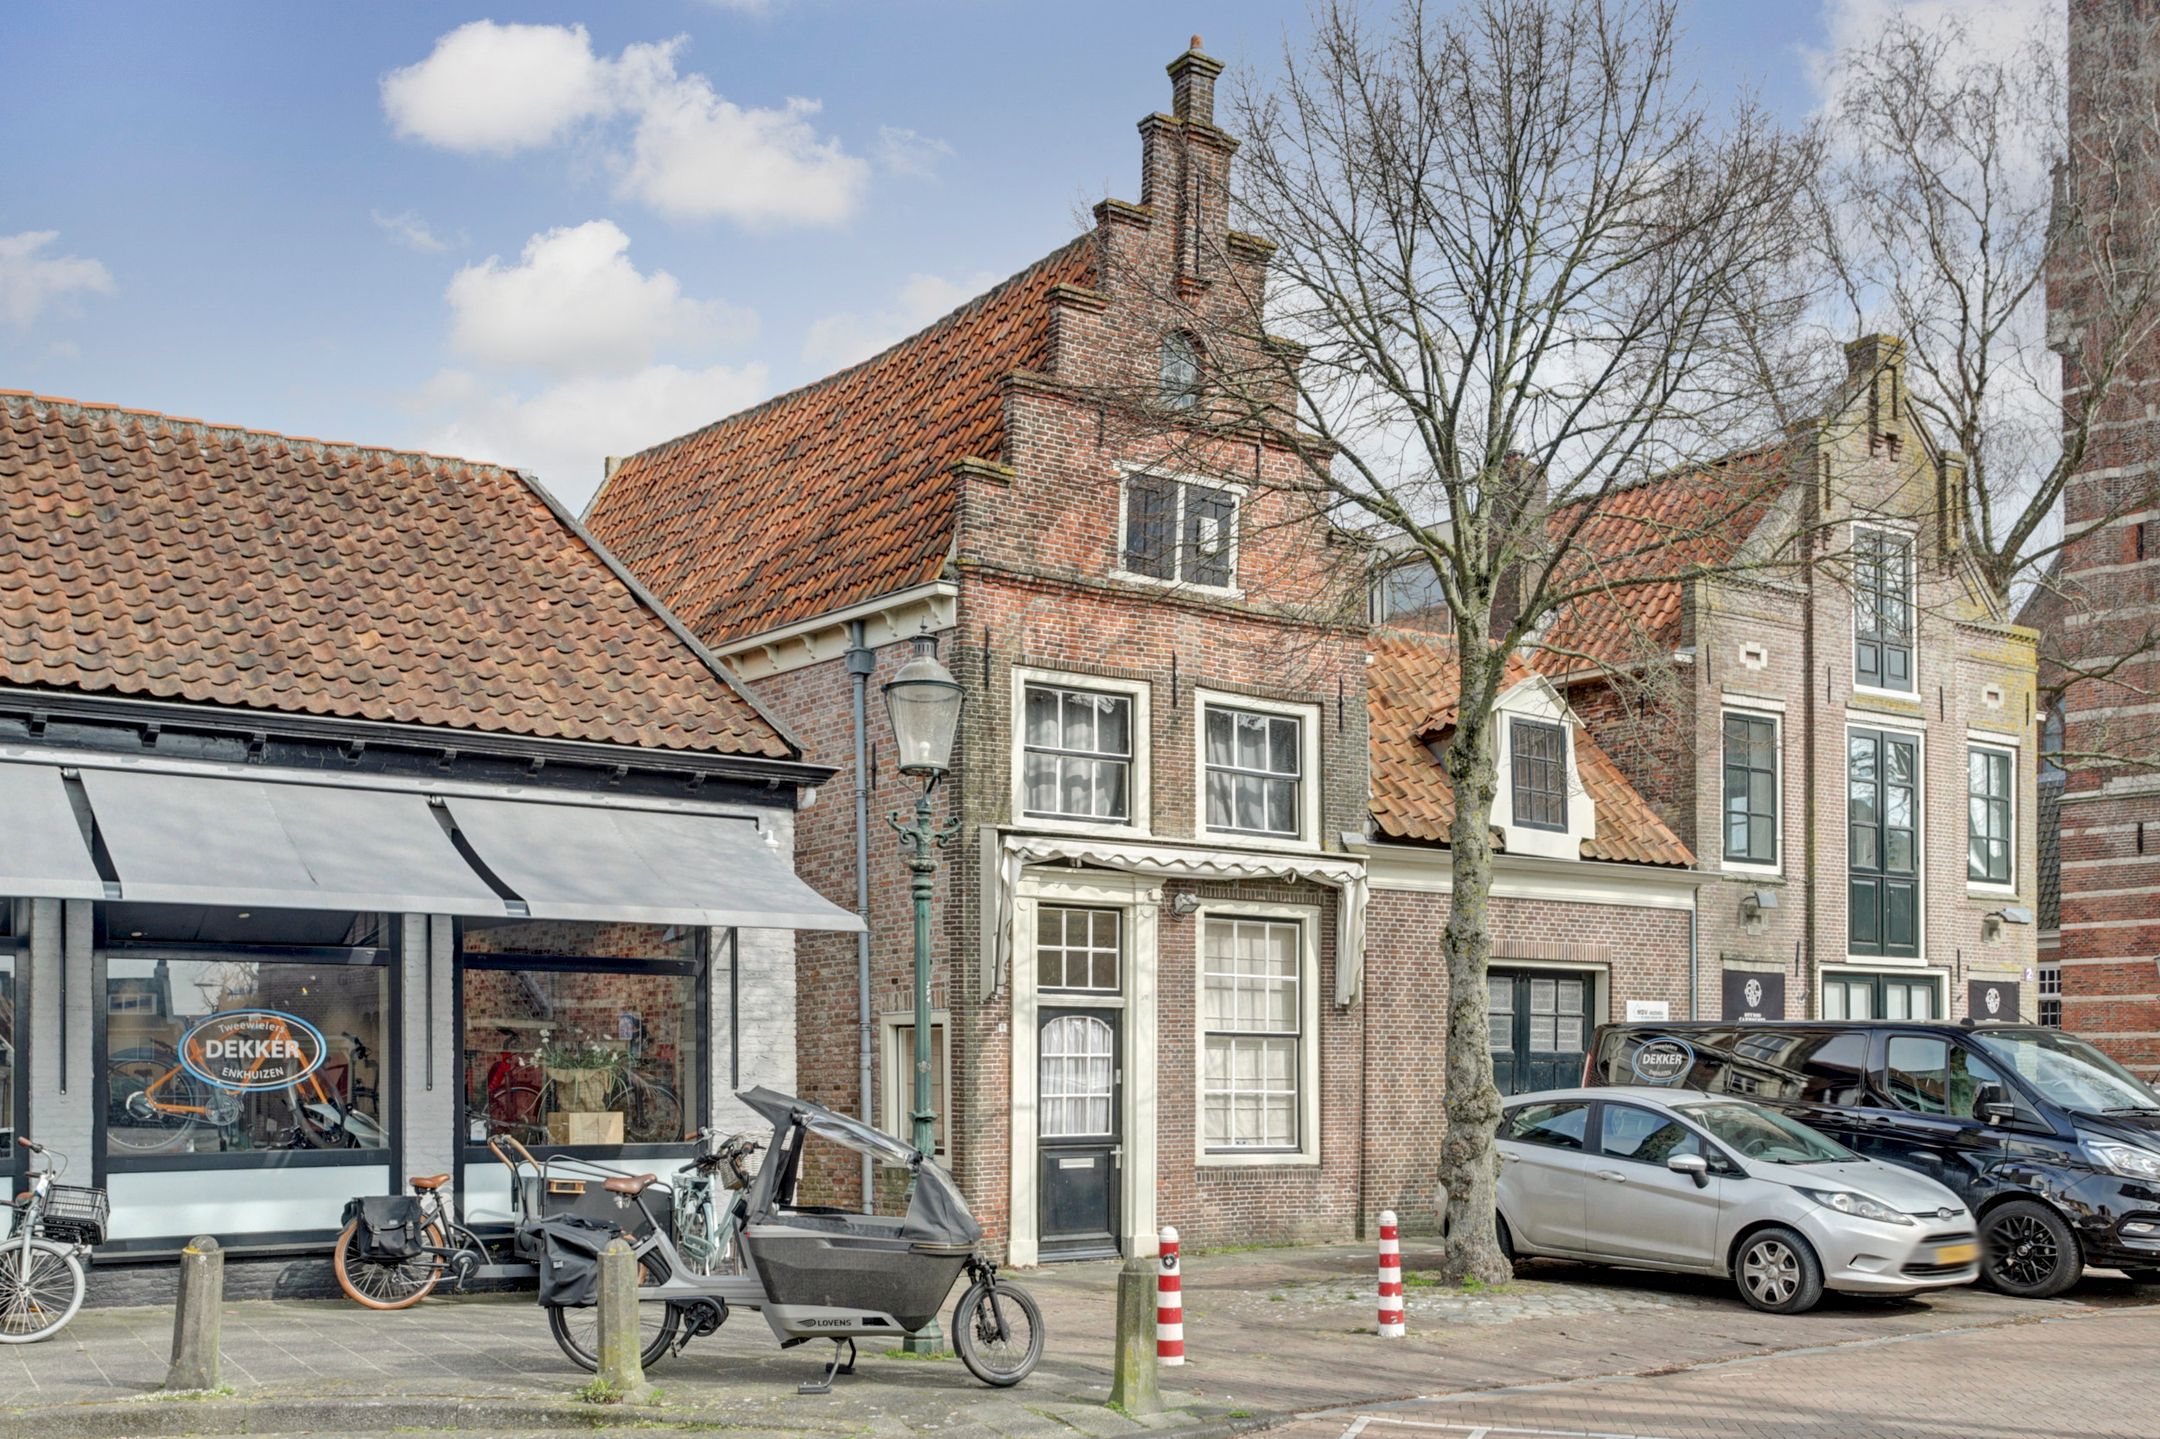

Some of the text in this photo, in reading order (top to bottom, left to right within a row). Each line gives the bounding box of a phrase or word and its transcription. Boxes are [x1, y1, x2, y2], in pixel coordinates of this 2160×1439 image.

[2025, 967, 2033, 980] 2
[218, 1021, 286, 1034] Tweewielers
[205, 1039, 300, 1059] DEKKER
[1642, 1053, 1683, 1065] DEKKER
[221, 1066, 285, 1080] ENKHUIZEN
[817, 1319, 852, 1327] LOVENS
